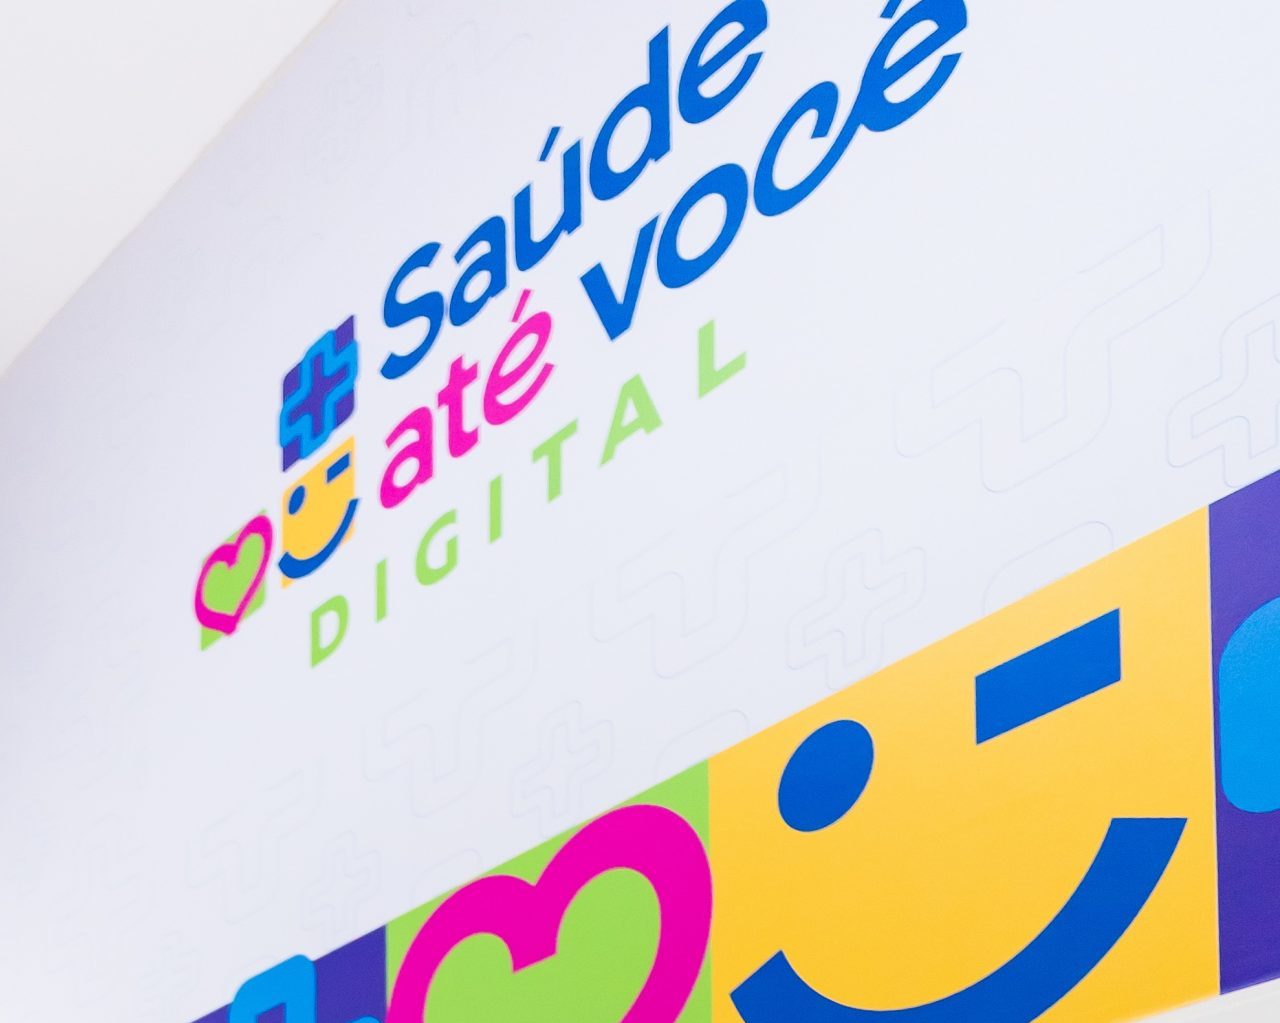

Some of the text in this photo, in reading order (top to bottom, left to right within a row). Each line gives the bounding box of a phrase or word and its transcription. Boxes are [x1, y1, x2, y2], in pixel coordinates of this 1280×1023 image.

[379, 0, 769, 380] Saúde
[309, 320, 747, 668] DIGITAL
[379, 288, 555, 510] até
